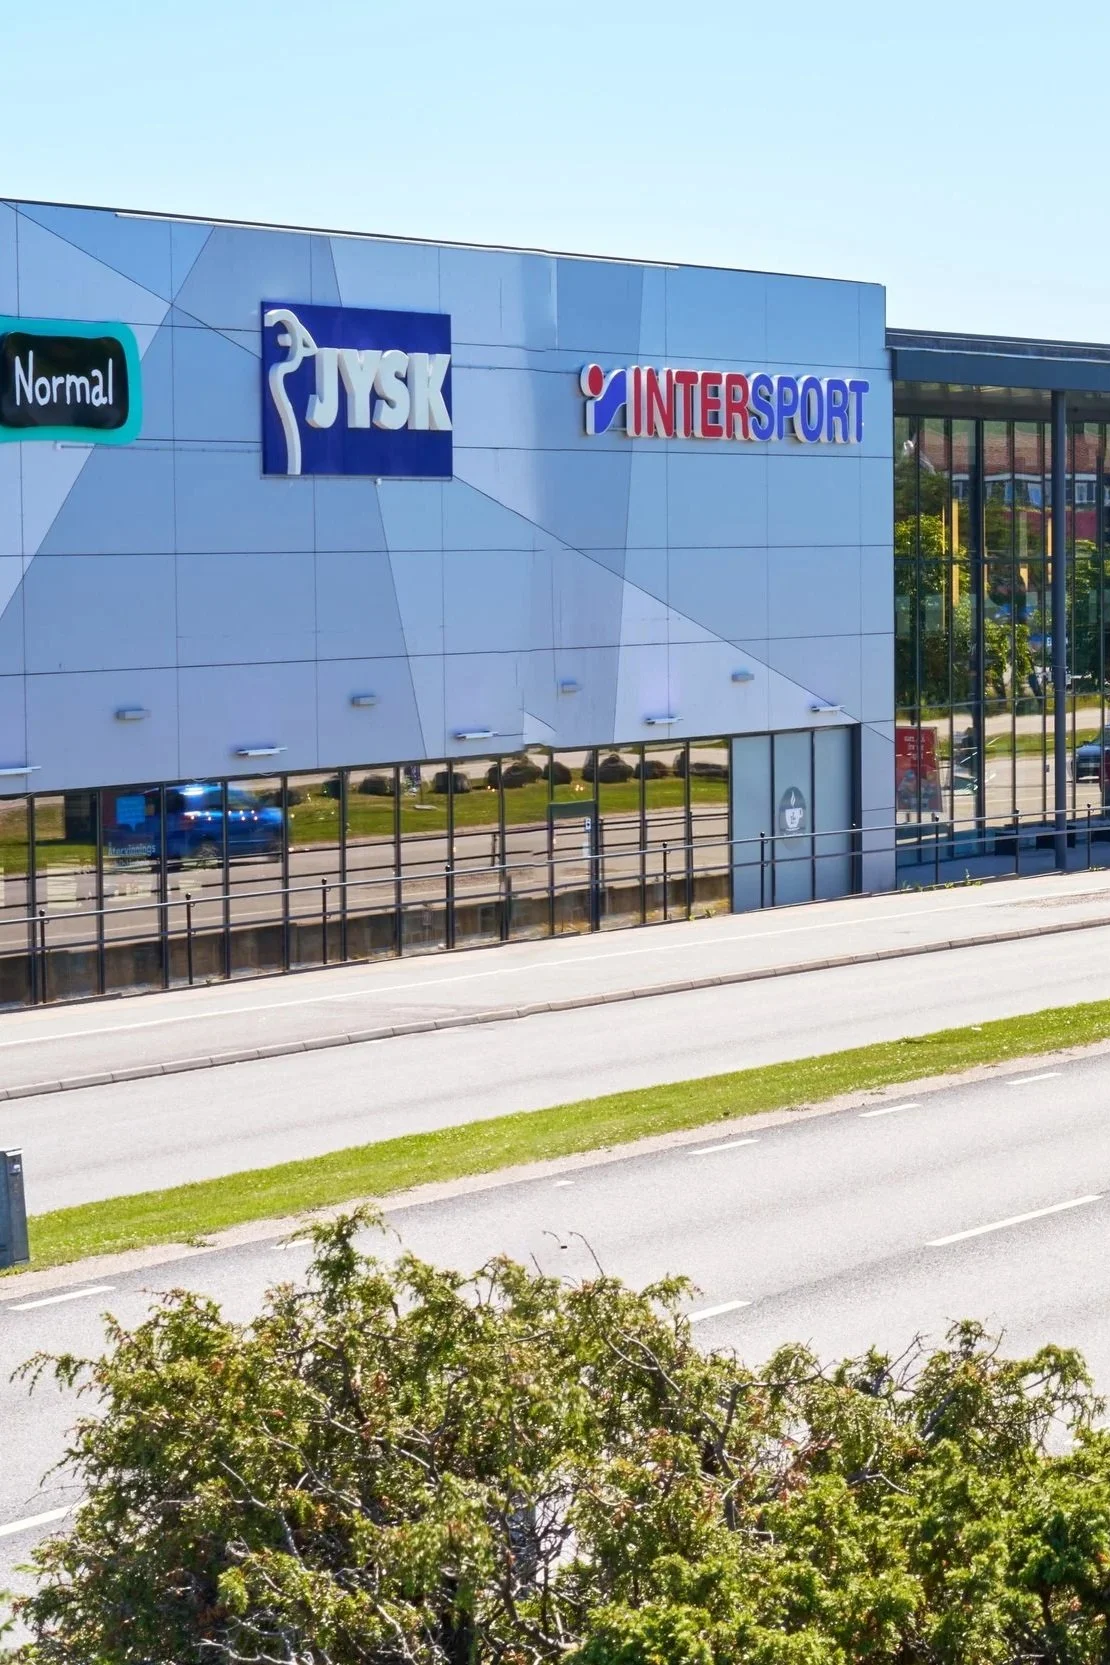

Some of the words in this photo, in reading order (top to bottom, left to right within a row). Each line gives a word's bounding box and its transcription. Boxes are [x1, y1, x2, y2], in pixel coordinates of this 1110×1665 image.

[14, 350, 114, 407] Normal
[305, 346, 453, 431] JYSK
[626, 366, 870, 443] INTERSPORT
